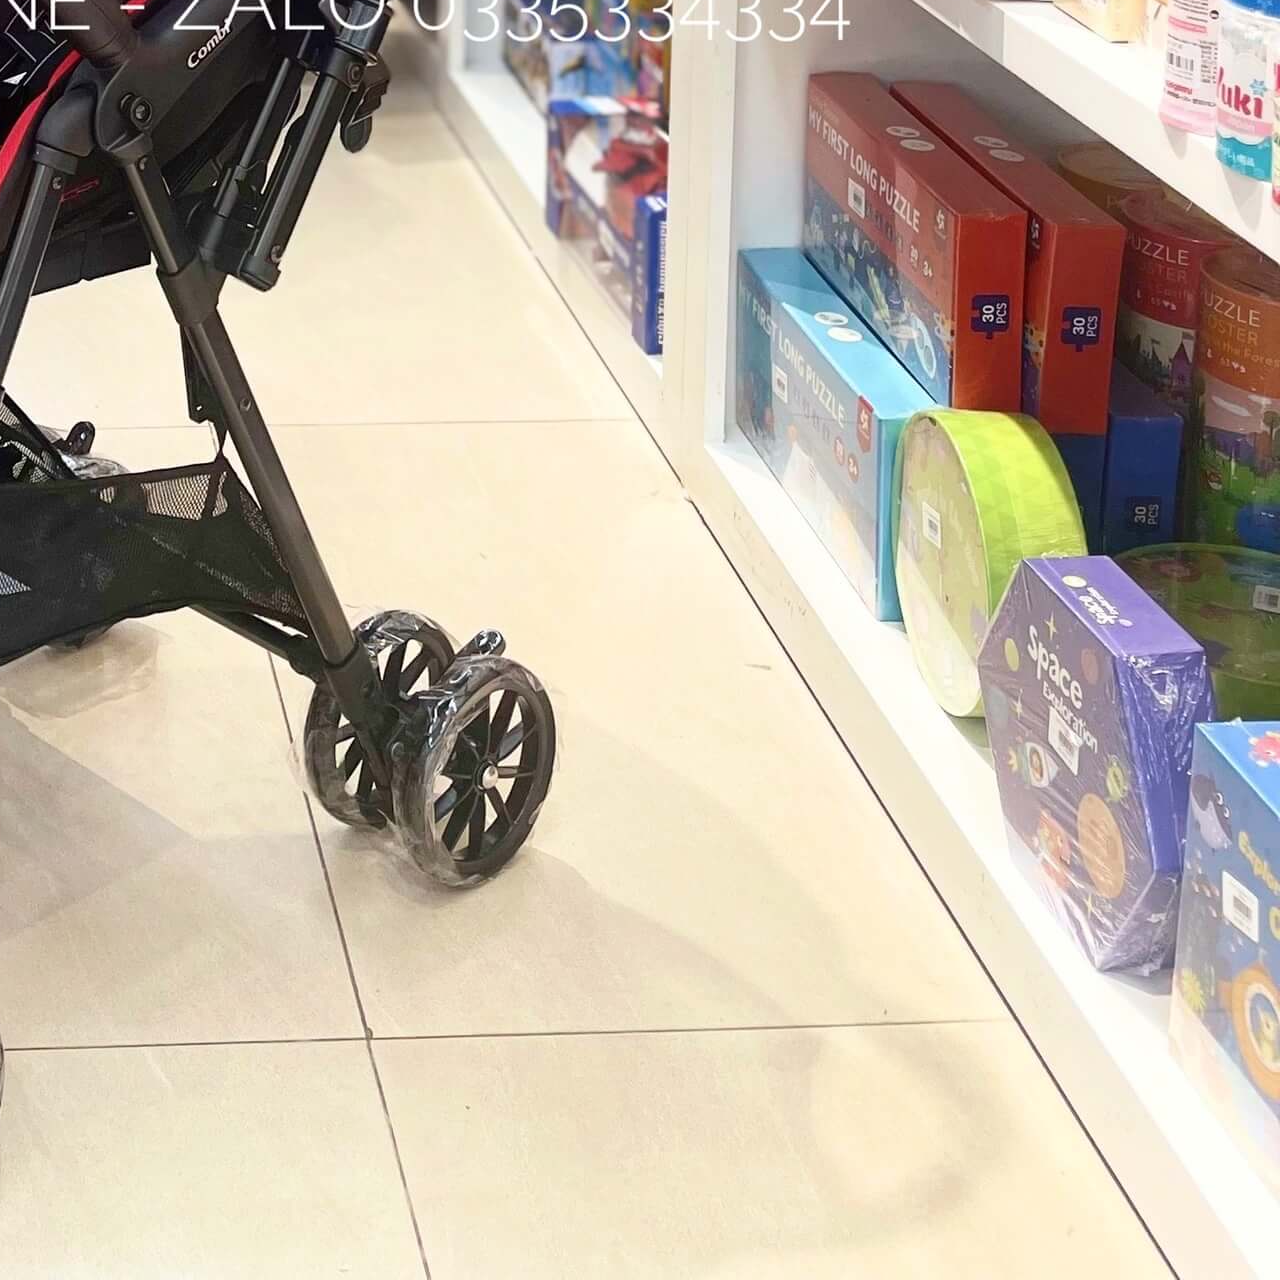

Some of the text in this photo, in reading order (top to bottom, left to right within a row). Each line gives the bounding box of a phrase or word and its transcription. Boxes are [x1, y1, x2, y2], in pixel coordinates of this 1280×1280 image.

[822, 120, 849, 161] FIRST
[850, 148, 878, 191] LONG
[879, 176, 920, 233] PUZZLE
[982, 304, 995, 323] 30
[996, 302, 1007, 324] PCS
[1073, 316, 1086, 336] 30
[1086, 315, 1098, 338] PCS
[752, 300, 845, 429] FIRST LONG PUZZLE
[1134, 506, 1147, 524] 30
[1028, 625, 1083, 710] Space
